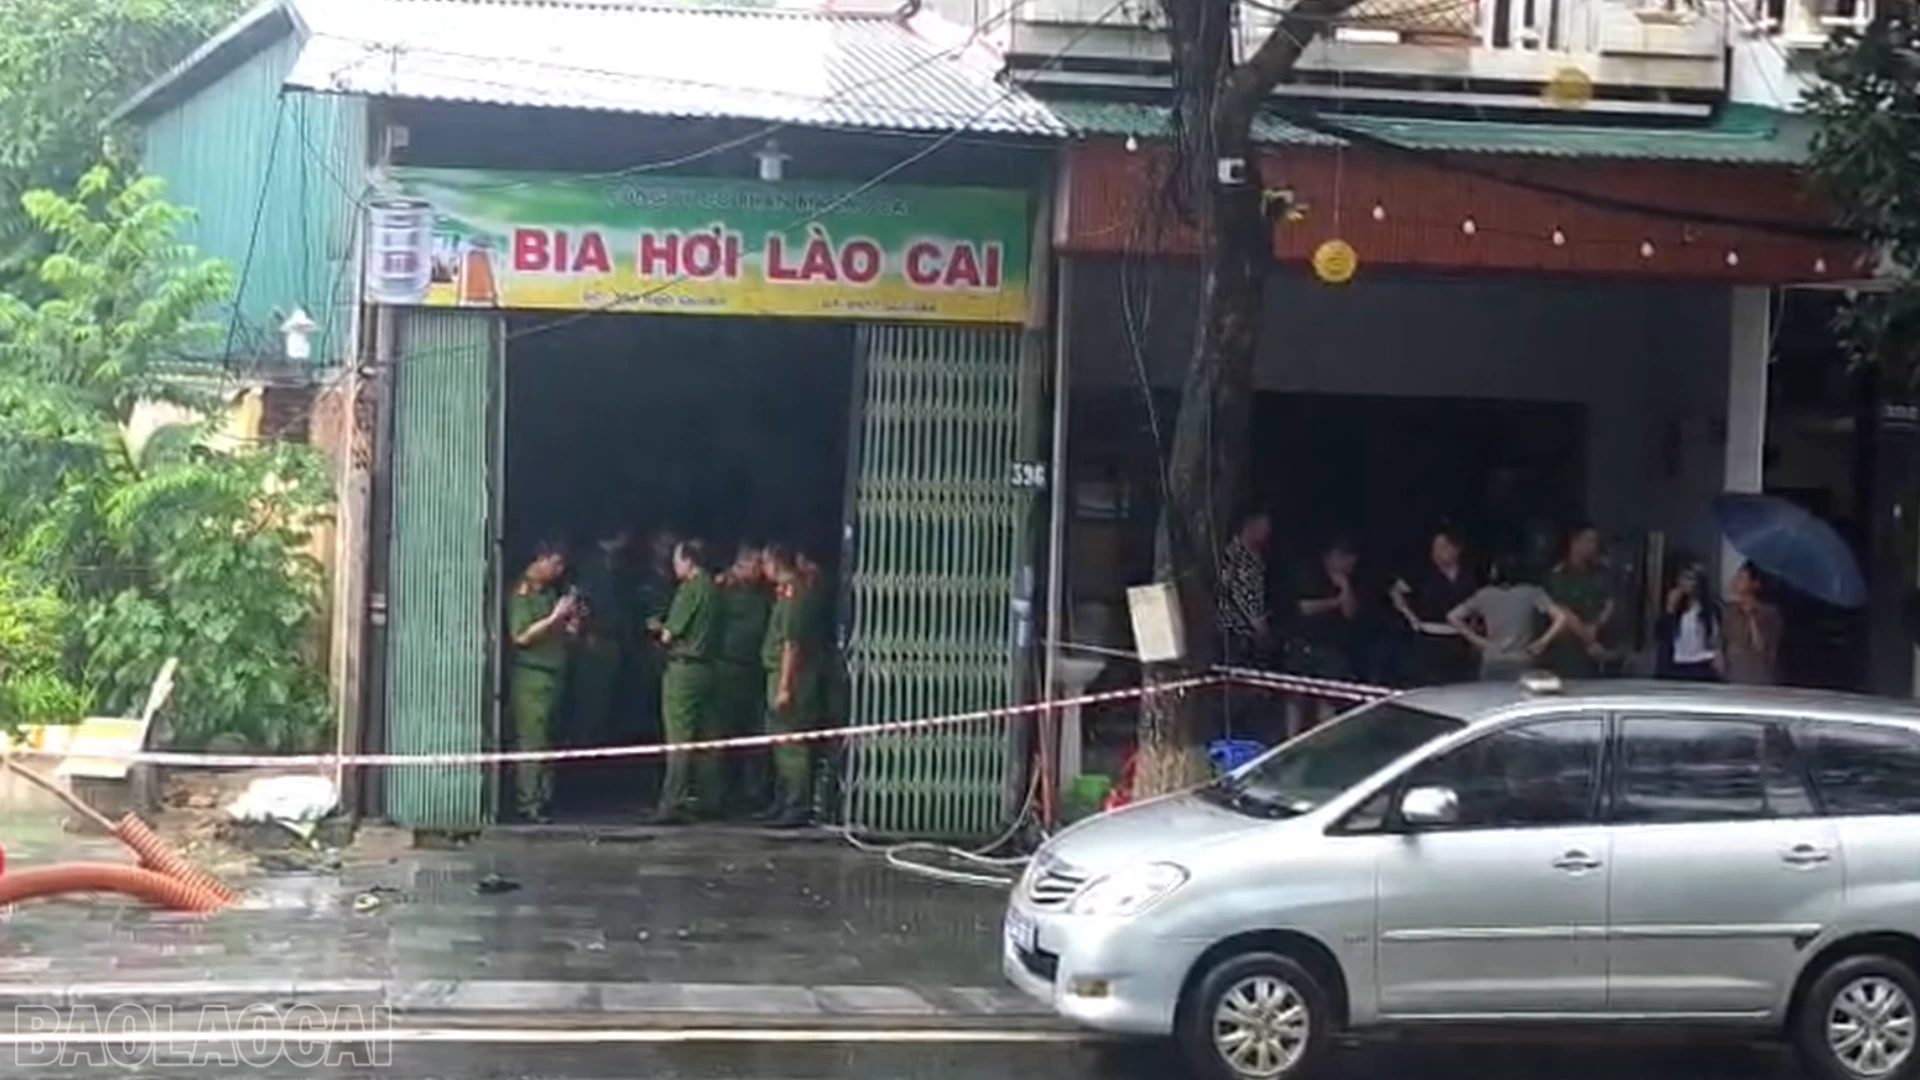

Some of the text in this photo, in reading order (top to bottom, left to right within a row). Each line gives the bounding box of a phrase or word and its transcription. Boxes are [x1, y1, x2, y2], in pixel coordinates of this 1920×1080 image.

[513, 226, 999, 287] BIA HƠI LÀO CAI
